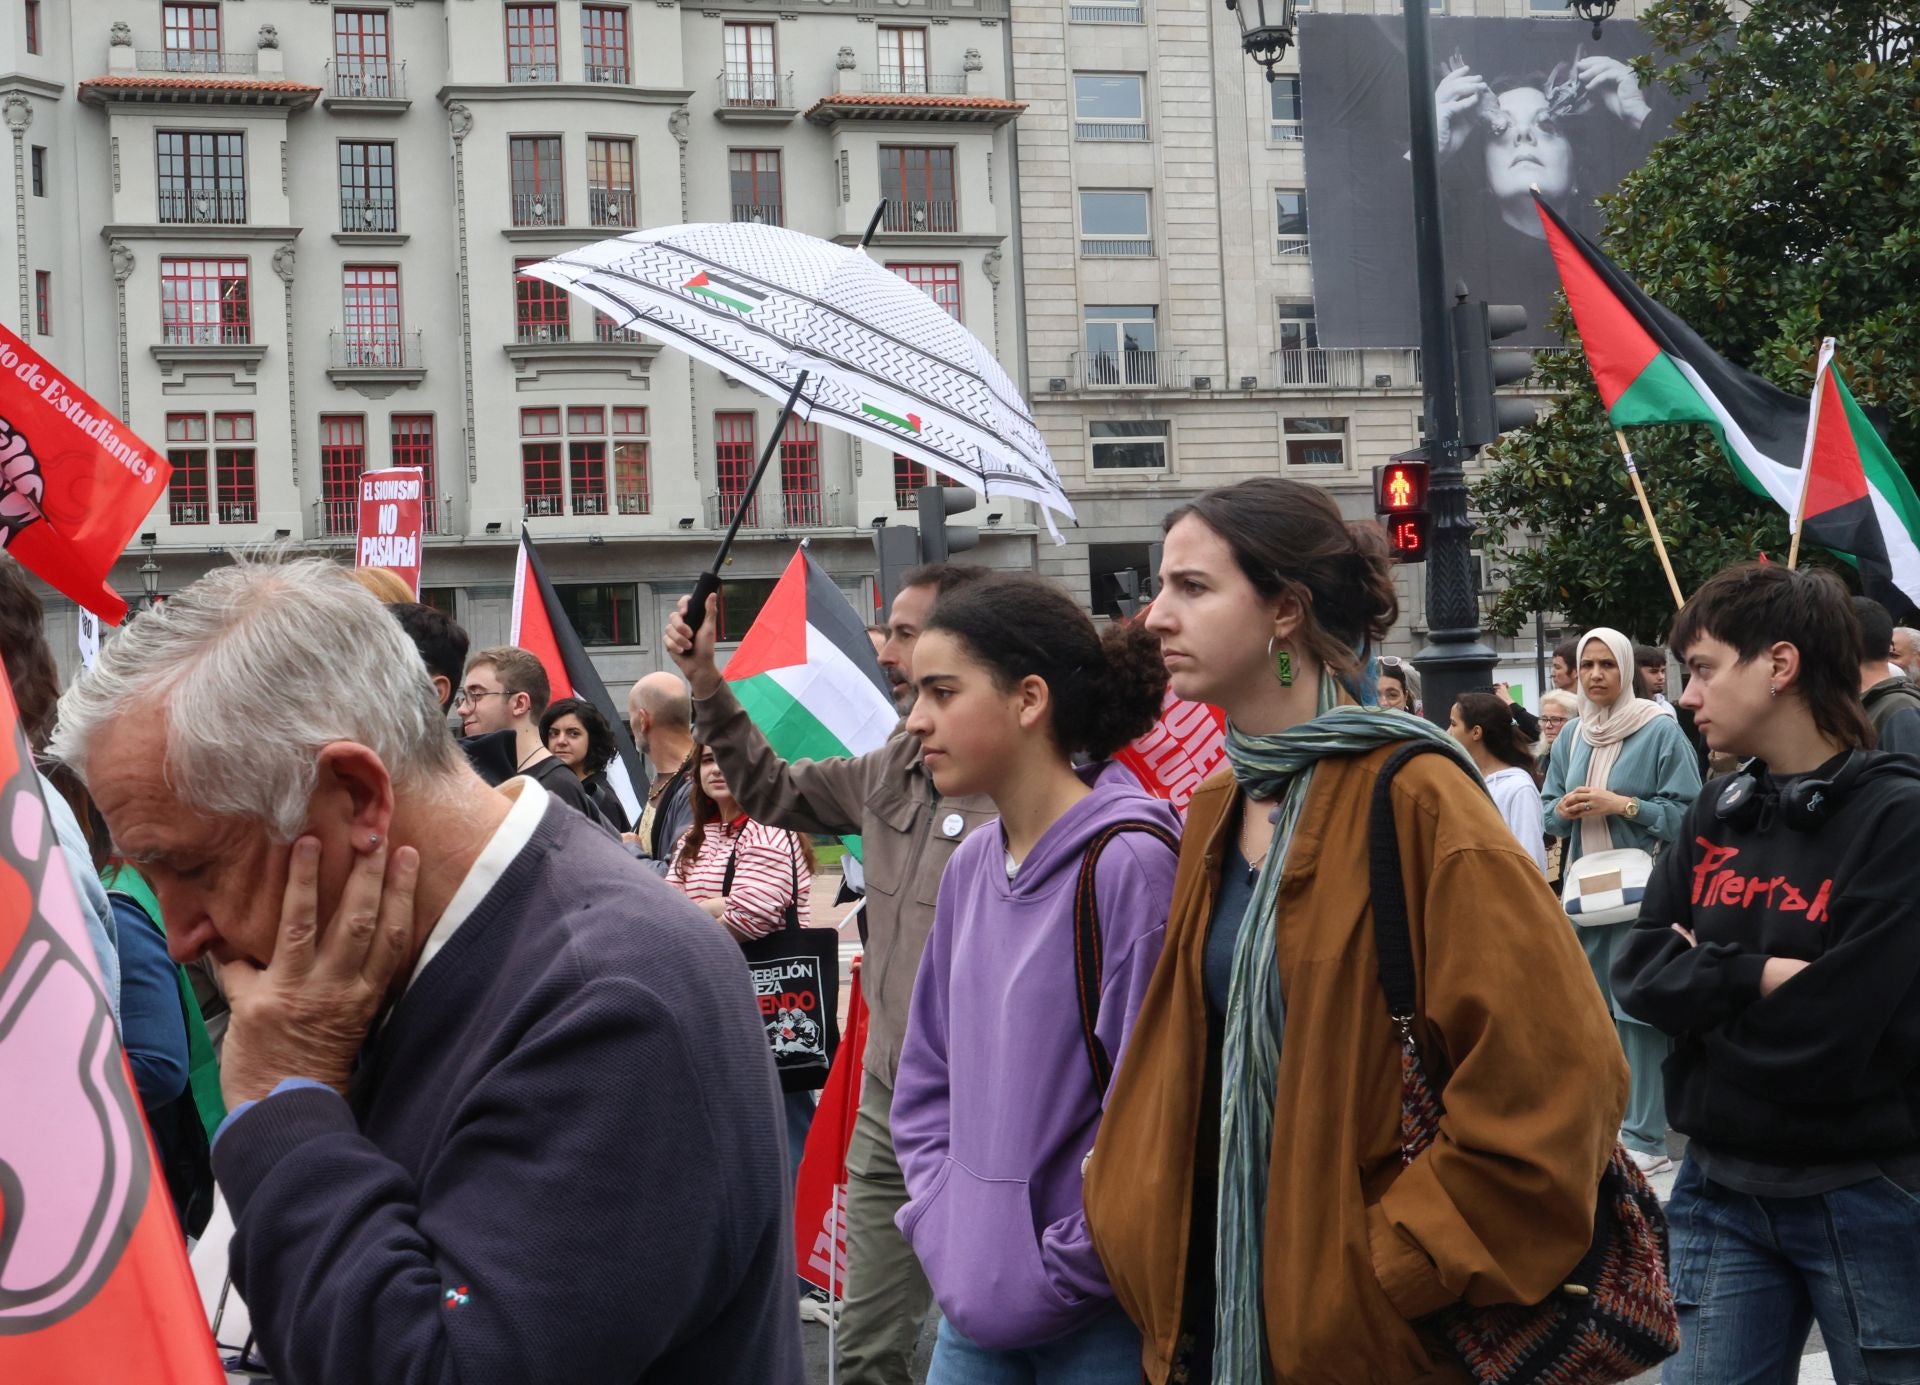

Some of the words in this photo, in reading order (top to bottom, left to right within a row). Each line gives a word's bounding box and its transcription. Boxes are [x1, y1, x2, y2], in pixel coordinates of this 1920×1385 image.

[0, 342, 18, 368] to
[15, 362, 46, 391] de
[40, 378, 157, 485] Estudiantes
[364, 481, 373, 500] EL
[374, 480, 419, 500] SIONISMO
[378, 503, 398, 535] NO
[360, 531, 416, 567] PASARÁ
[1398, 523, 1418, 548] 15
[1163, 683, 1233, 782] UIE
[758, 990, 816, 1015] ENDO
